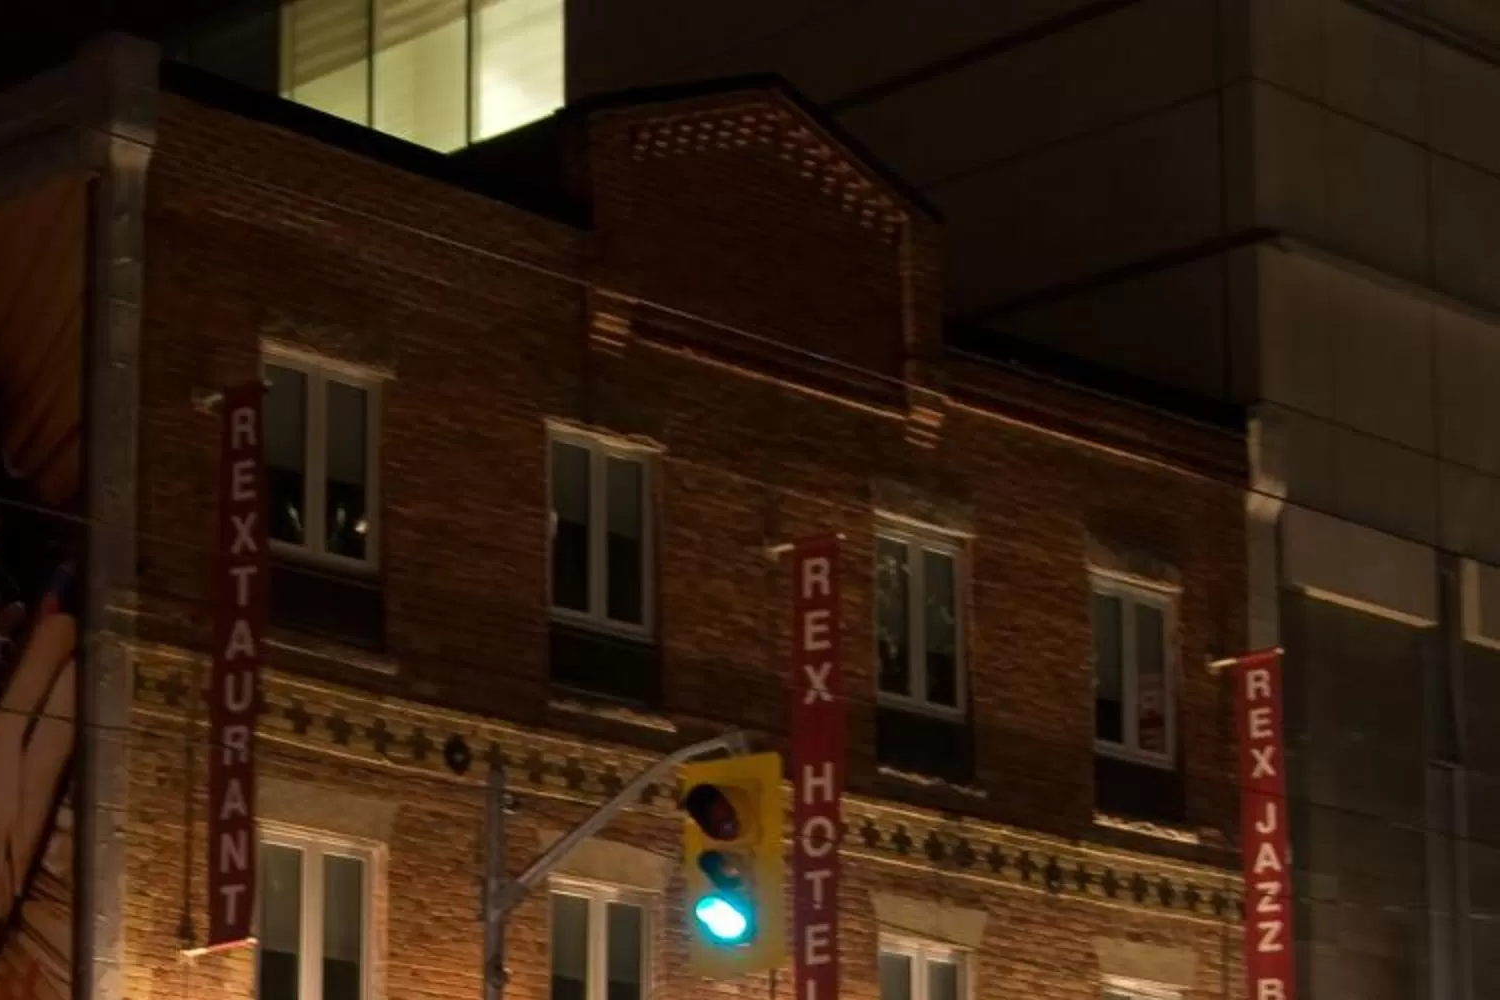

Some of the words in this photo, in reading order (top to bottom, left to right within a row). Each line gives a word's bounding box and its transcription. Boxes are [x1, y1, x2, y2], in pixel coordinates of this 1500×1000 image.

[220, 406, 258, 926] REXTAURANT
[801, 557, 834, 704] REX
[1244, 668, 1277, 778] REX
[1252, 801, 1283, 954] JAZZ
